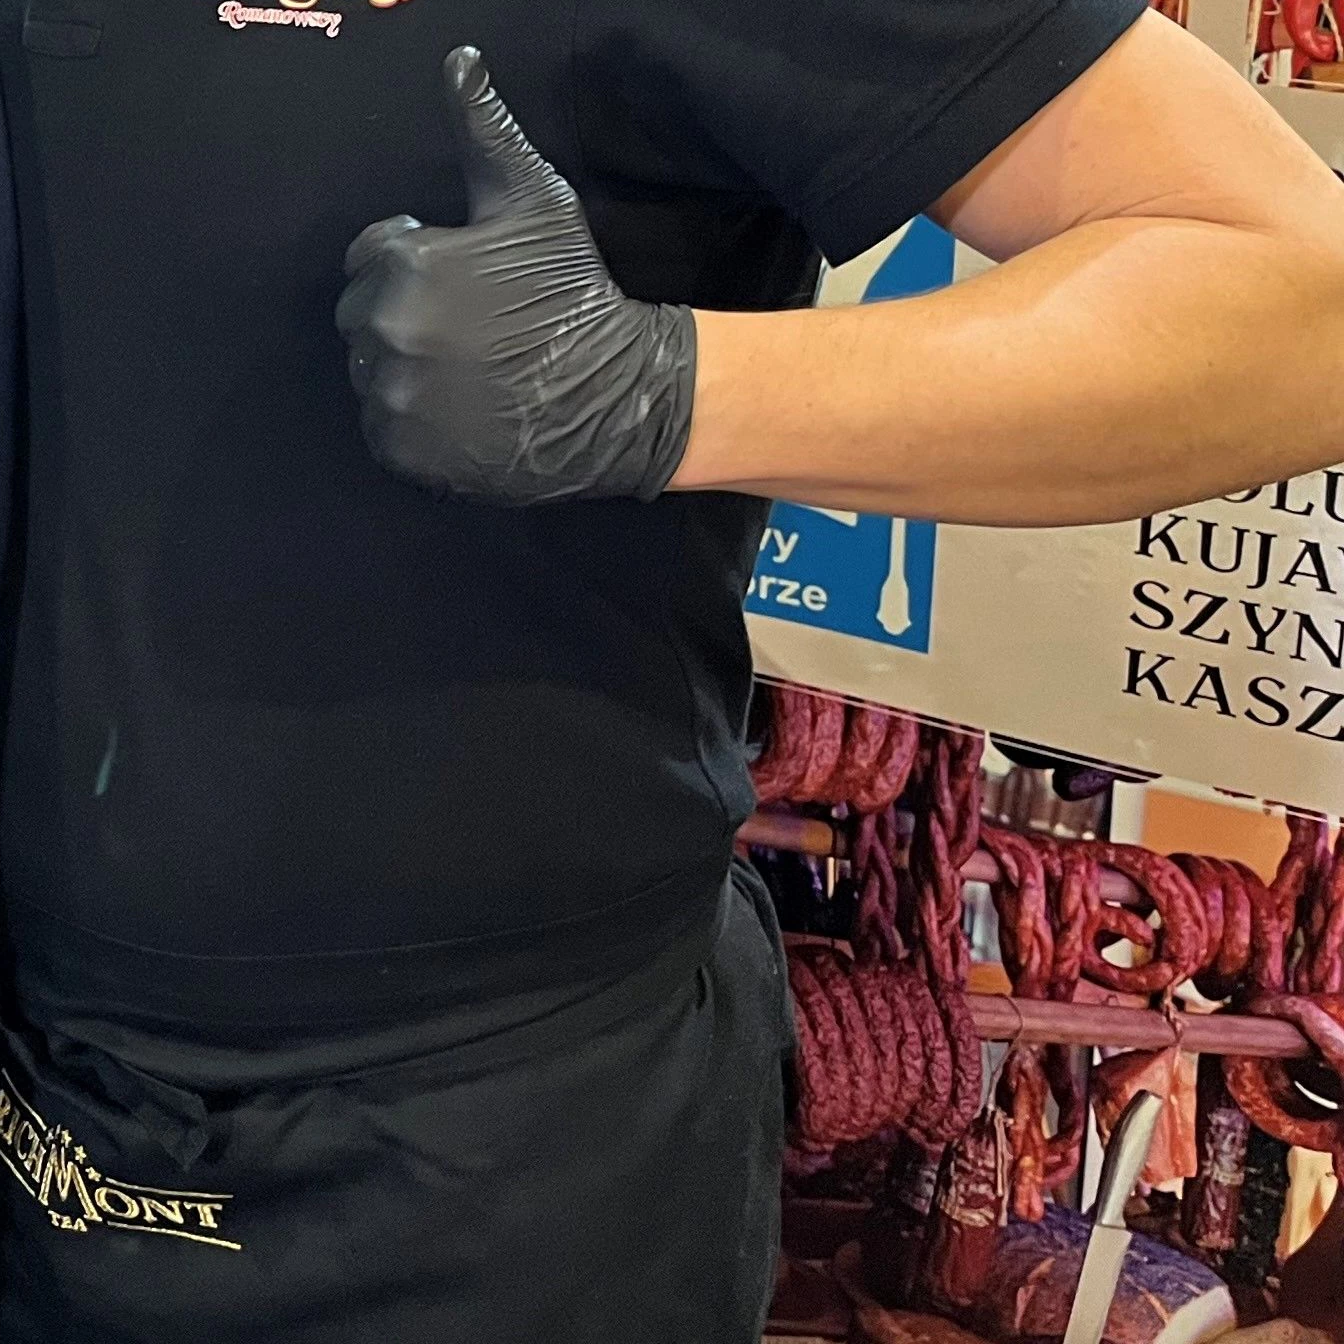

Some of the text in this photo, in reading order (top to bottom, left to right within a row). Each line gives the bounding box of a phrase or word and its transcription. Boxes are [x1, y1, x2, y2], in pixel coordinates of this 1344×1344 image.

[1134, 512, 1344, 595] KUJA
[1121, 646, 1344, 743] KASZ
[47, 1209, 88, 1233] TEA
